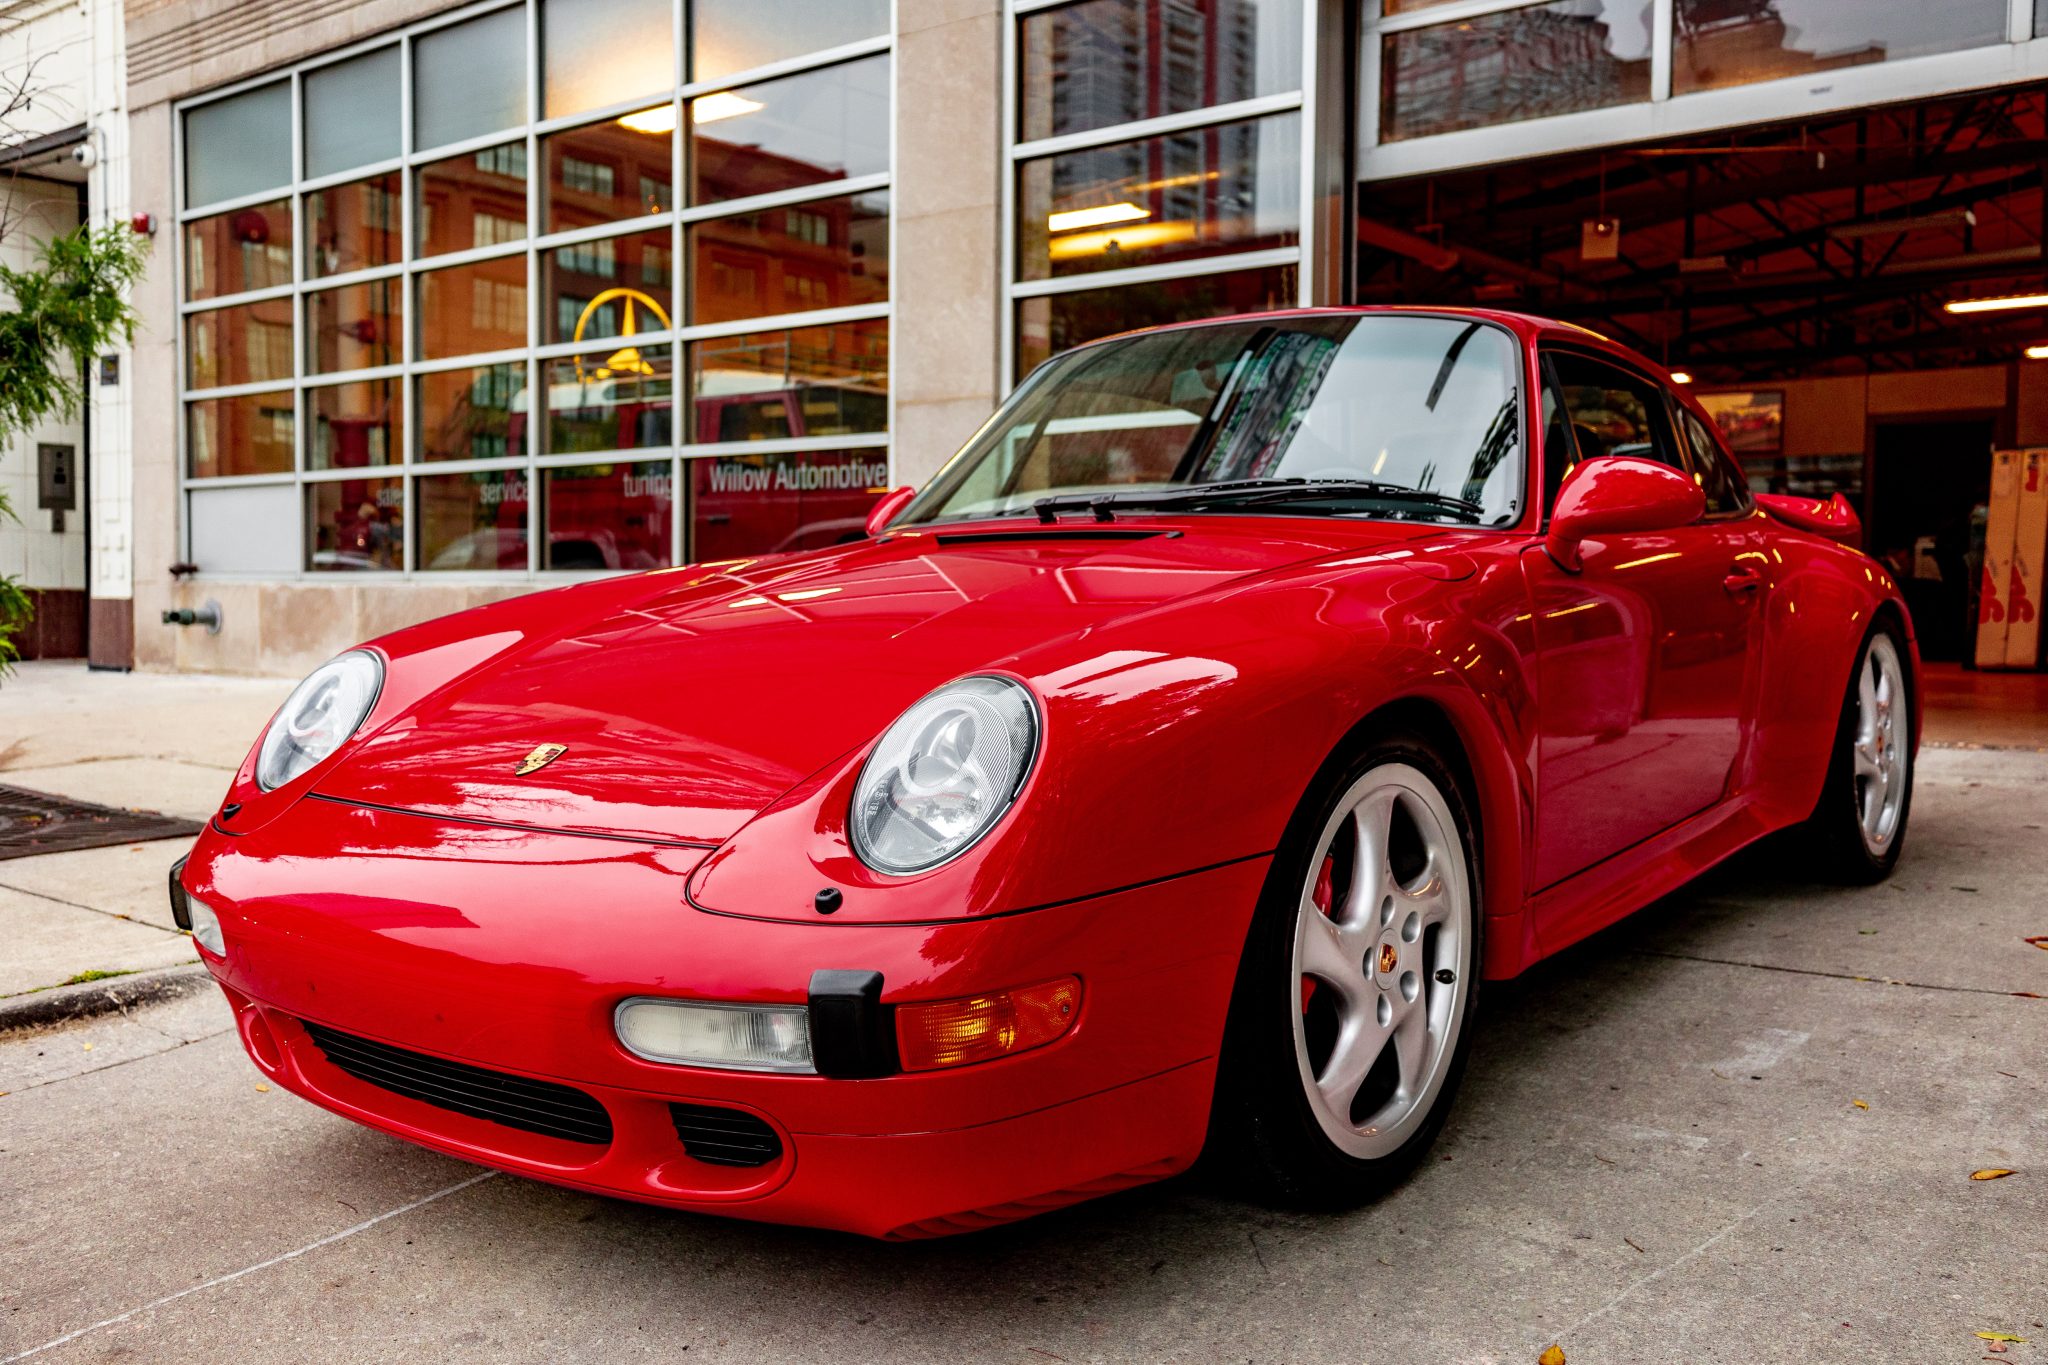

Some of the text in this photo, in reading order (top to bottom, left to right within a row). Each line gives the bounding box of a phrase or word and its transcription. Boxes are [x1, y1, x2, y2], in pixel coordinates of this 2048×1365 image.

[623, 468, 672, 500] tuning
[709, 457, 887, 493] Willow Automotive
